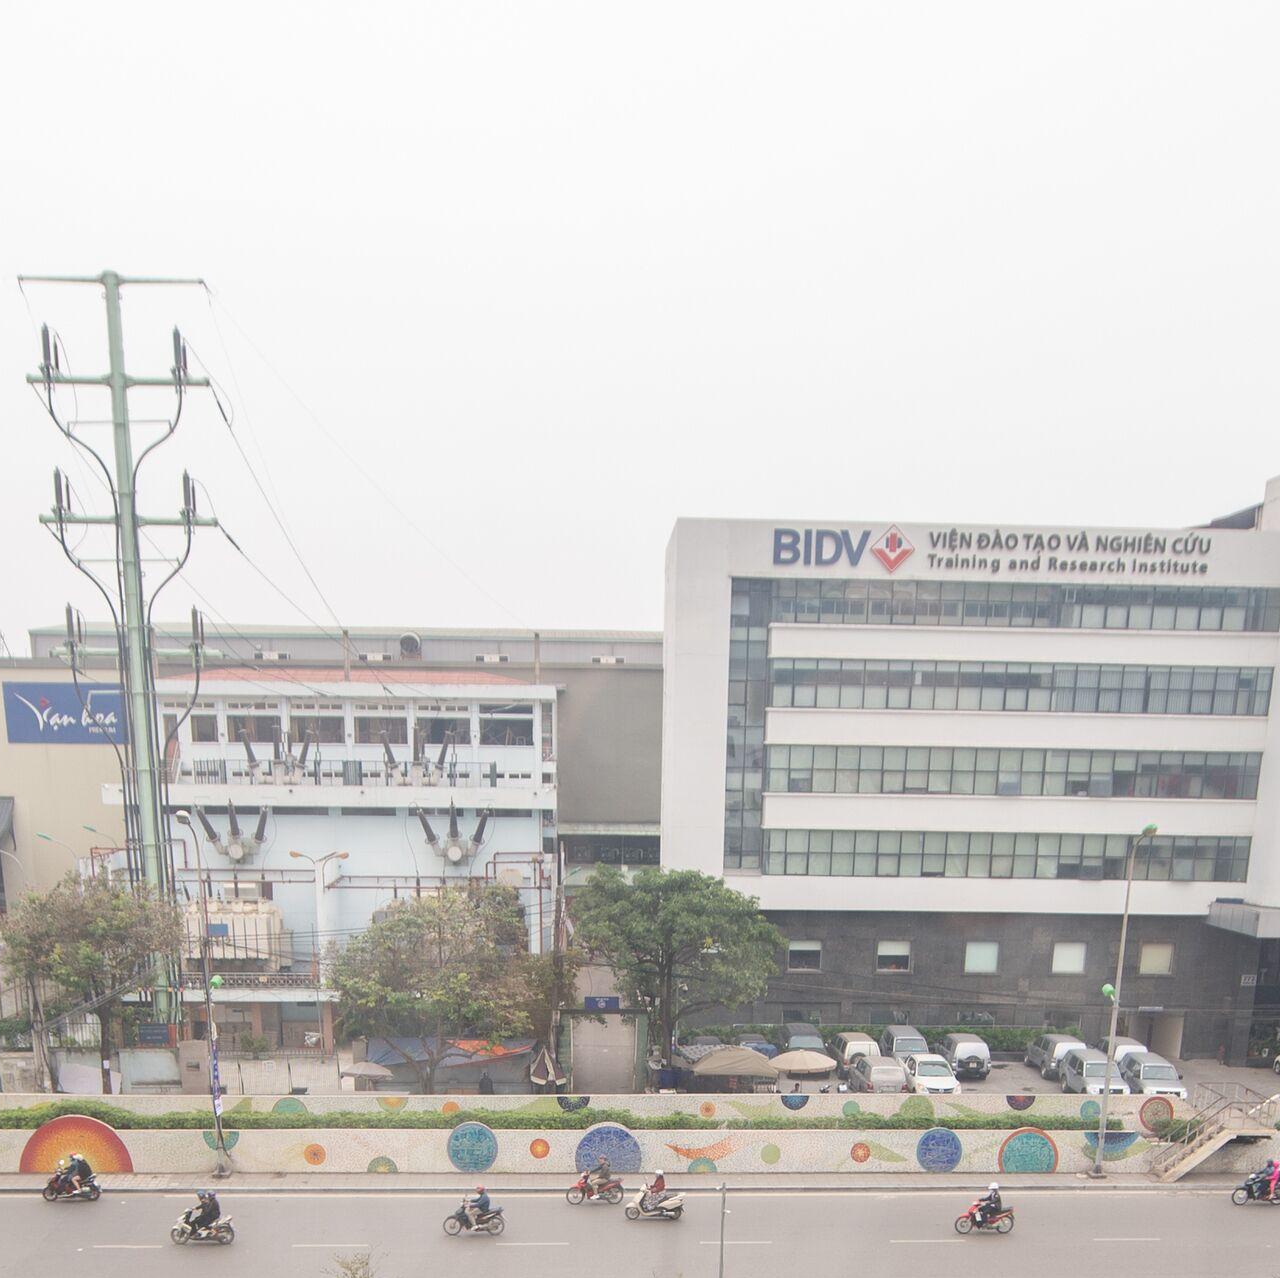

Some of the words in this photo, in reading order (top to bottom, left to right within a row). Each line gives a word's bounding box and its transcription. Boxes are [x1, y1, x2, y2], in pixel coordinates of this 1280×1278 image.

[773, 528, 871, 567] BIDV
[928, 528, 972, 553] VIỆN
[977, 529, 1018, 551] ĐÀO
[1023, 532, 1061, 554] TẠO
[1066, 531, 1090, 551] VÀ
[1096, 532, 1167, 553] NGHIÊN
[1172, 533, 1212, 554] CỨU
[928, 554, 1001, 573] Training
[1009, 555, 1041, 571] and
[1048, 557, 1126, 573] Research
[1132, 558, 1209, 574] Institute
